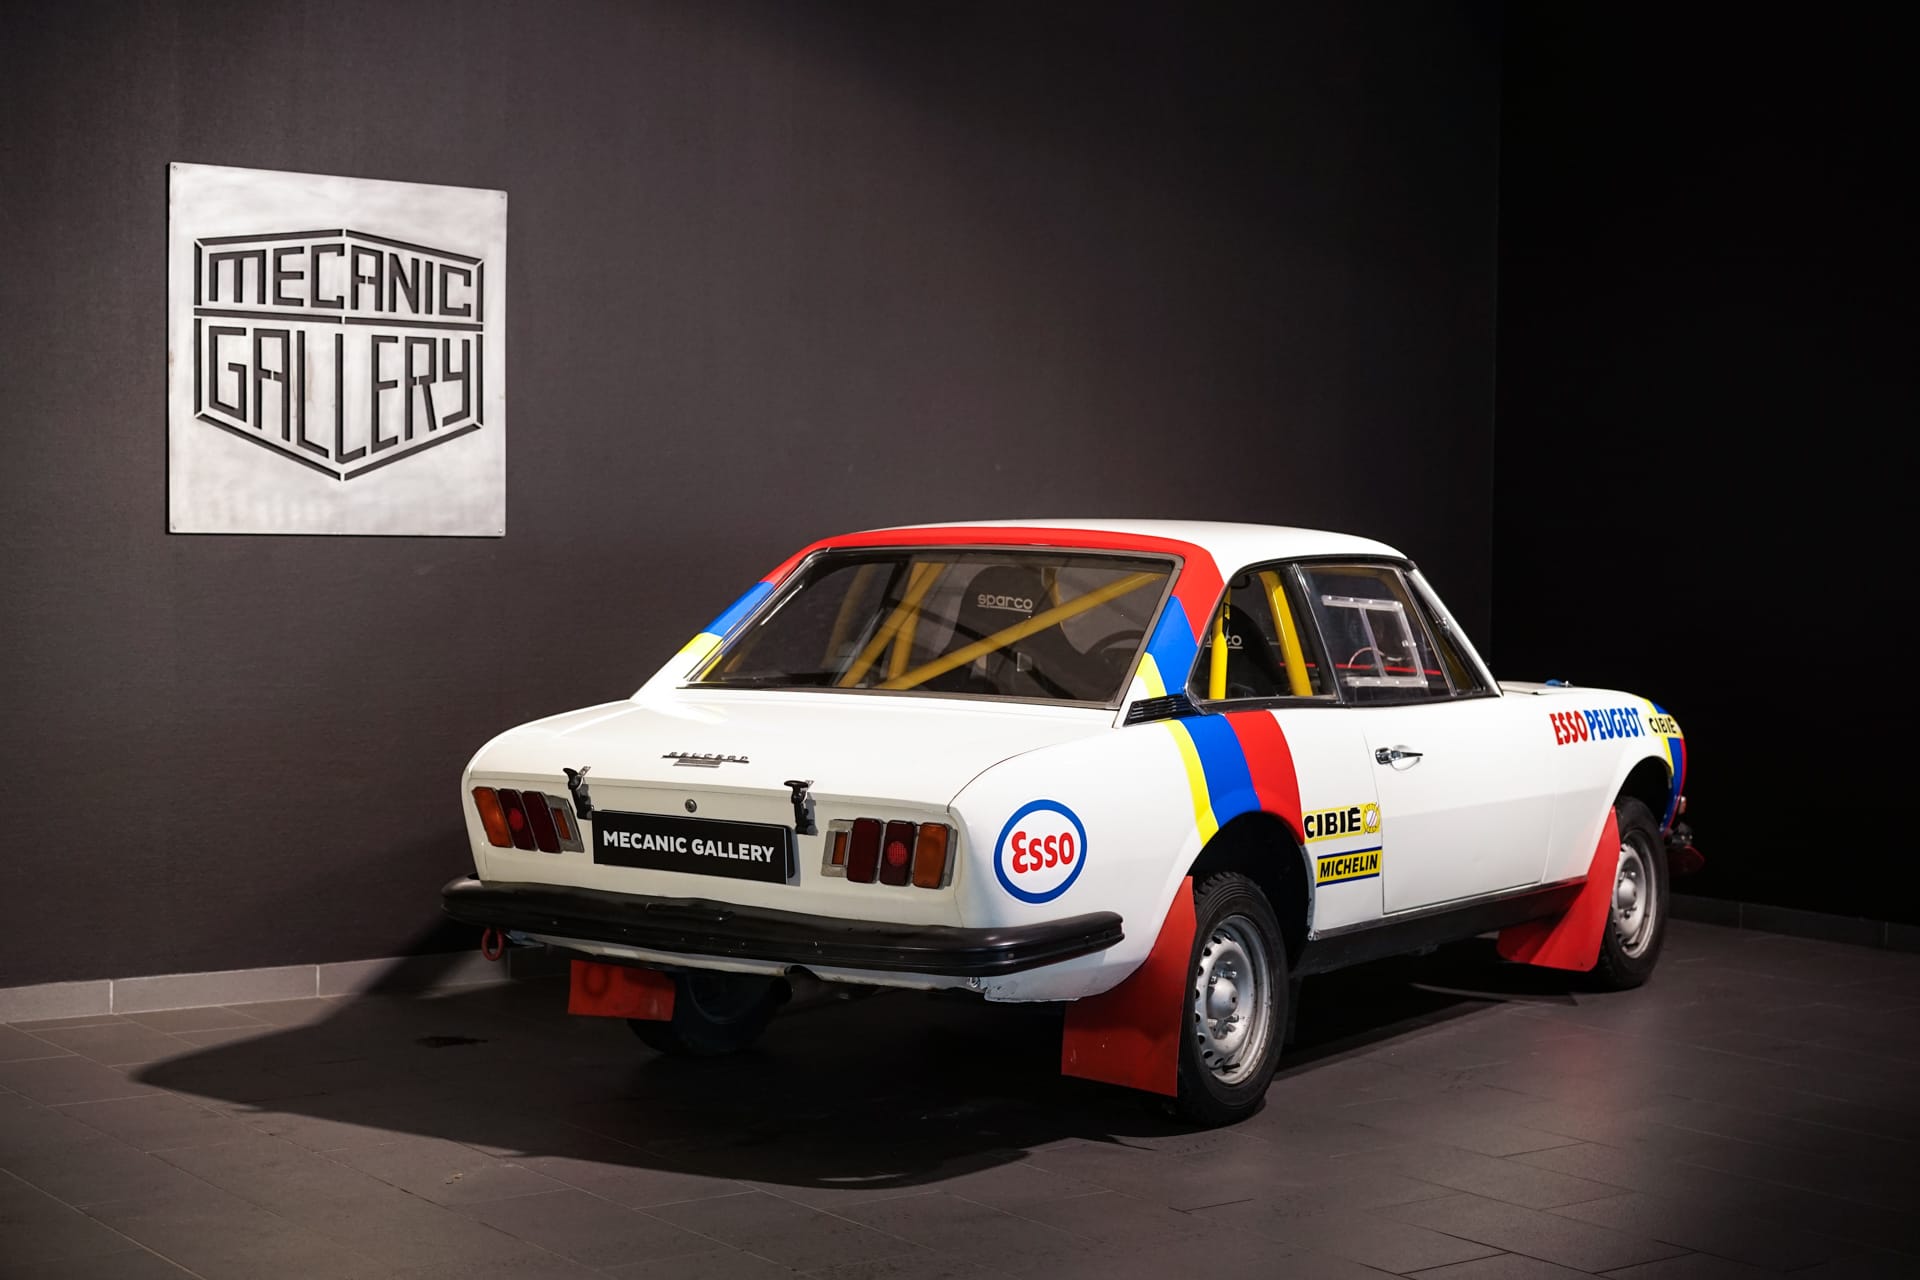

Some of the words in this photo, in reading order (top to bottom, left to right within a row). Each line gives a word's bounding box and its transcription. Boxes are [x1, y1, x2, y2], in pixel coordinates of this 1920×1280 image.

[208, 243, 472, 317] MECANIC
[208, 325, 471, 465] GALLERY
[977, 593, 1033, 610] sparco
[1549, 710, 1588, 746] ESSO
[1583, 707, 1646, 741] PEUGEOT
[602, 830, 687, 854] MECANIC
[691, 838, 775, 863] GALLERY
[1319, 853, 1379, 879] MICHELIN
